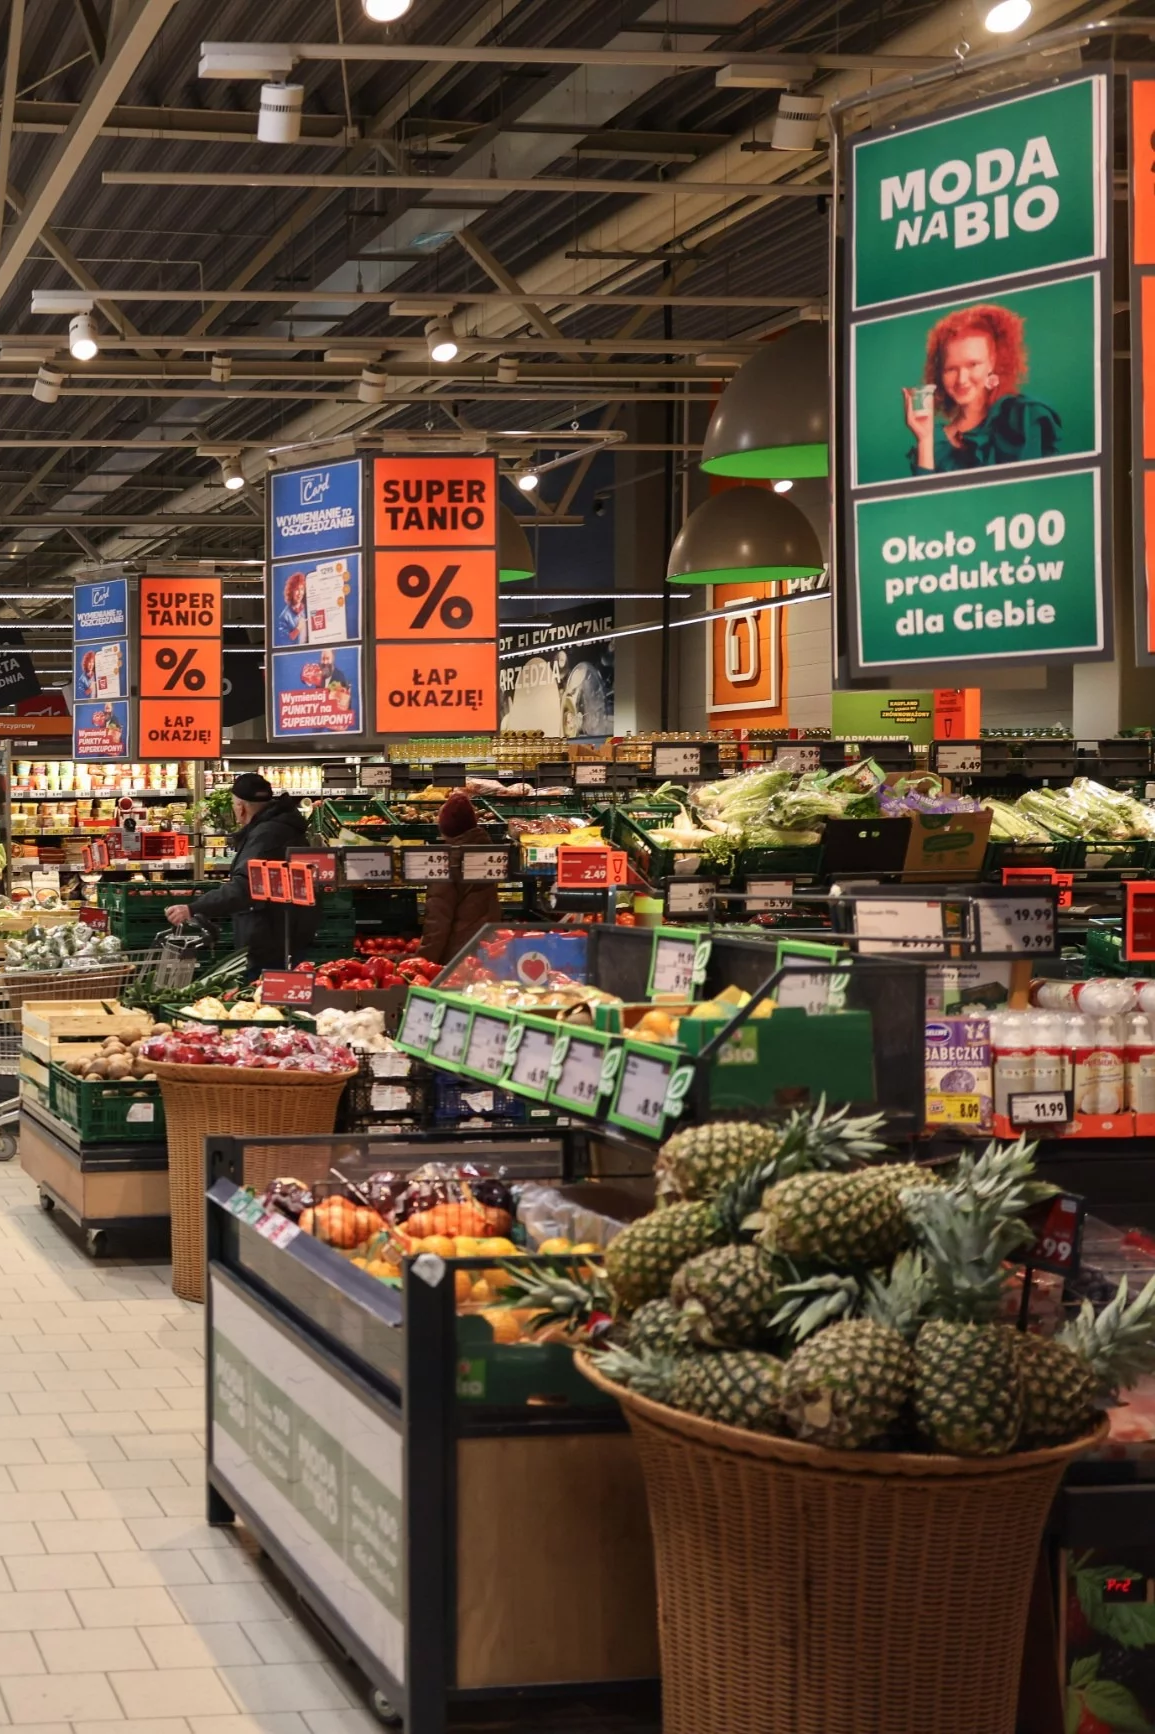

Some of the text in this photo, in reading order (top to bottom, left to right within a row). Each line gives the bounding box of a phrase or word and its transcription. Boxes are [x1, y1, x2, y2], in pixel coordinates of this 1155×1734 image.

[880, 136, 1060, 221] MODA
[895, 185, 1060, 250] NA BIO
[303, 473, 330, 502] Card
[383, 479, 486, 504] SUPER
[276, 507, 352, 528] WYMIENIANIE TO
[385, 506, 485, 531] TANIO
[281, 516, 355, 536] OSZCZĘDZANIE!
[881, 510, 1066, 564] Około 100
[885, 556, 1065, 603] produktów
[147, 592, 214, 608] SUPER
[397, 564, 474, 630] %
[148, 610, 214, 626] TANIO
[895, 598, 1056, 637] dla Ciebie
[155, 648, 205, 691] %
[412, 668, 457, 686] ŁAP
[280, 690, 326, 704] Wymieniaj
[388, 689, 484, 711] OKAZJĘ!
[281, 703, 333, 716] PUNKTY na
[0, 722, 36, 731] Przyprawy
[163, 716, 195, 728] ŁAP
[281, 713, 353, 729] SUPERKUPONY!
[148, 729, 212, 744] OKAZJĘ!
[799, 750, 820, 759] 5.99
[799, 763, 820, 772] 5.49
[960, 761, 981, 770] 4.49
[428, 855, 448, 864] 4.99
[488, 855, 509, 864] 4.69
[369, 868, 391, 878] 13.49
[428, 868, 448, 877] 6.99
[488, 868, 509, 877] 4.99
[584, 869, 606, 880] 2.49
[1013, 908, 1052, 921] 19.99
[1022, 935, 1053, 948] 9.99
[288, 989, 312, 1000] 2.49
[925, 1046, 985, 1061] BABECZKI
[960, 1103, 979, 1118] 8.09
[1034, 1101, 1064, 1118] 11.99
